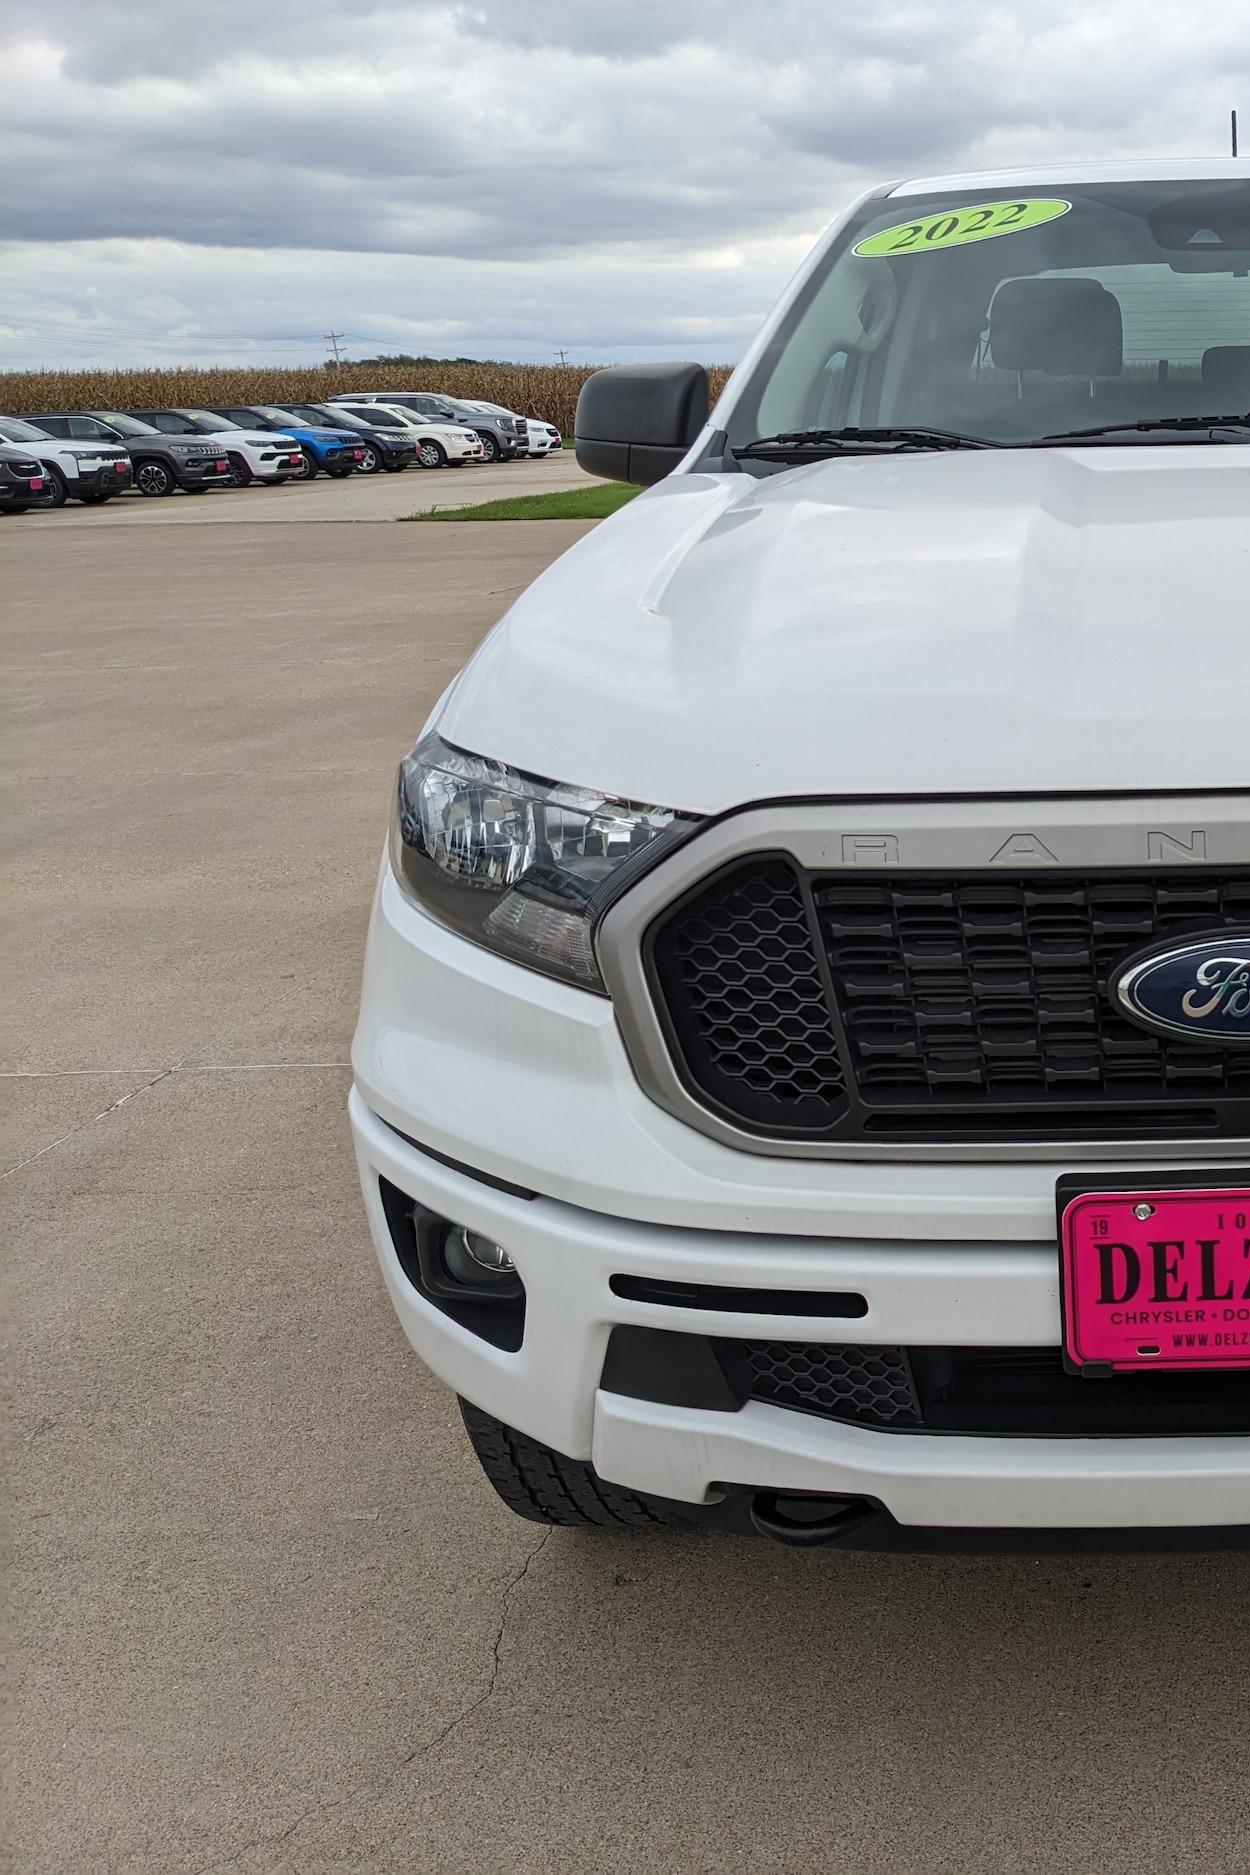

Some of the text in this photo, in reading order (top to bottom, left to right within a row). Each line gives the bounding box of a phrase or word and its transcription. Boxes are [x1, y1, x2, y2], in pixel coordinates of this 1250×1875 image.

[886, 203, 1028, 251] 2022
[1091, 1219, 1109, 1236] 19
[1110, 1309, 1206, 1325] CHRYSLER
